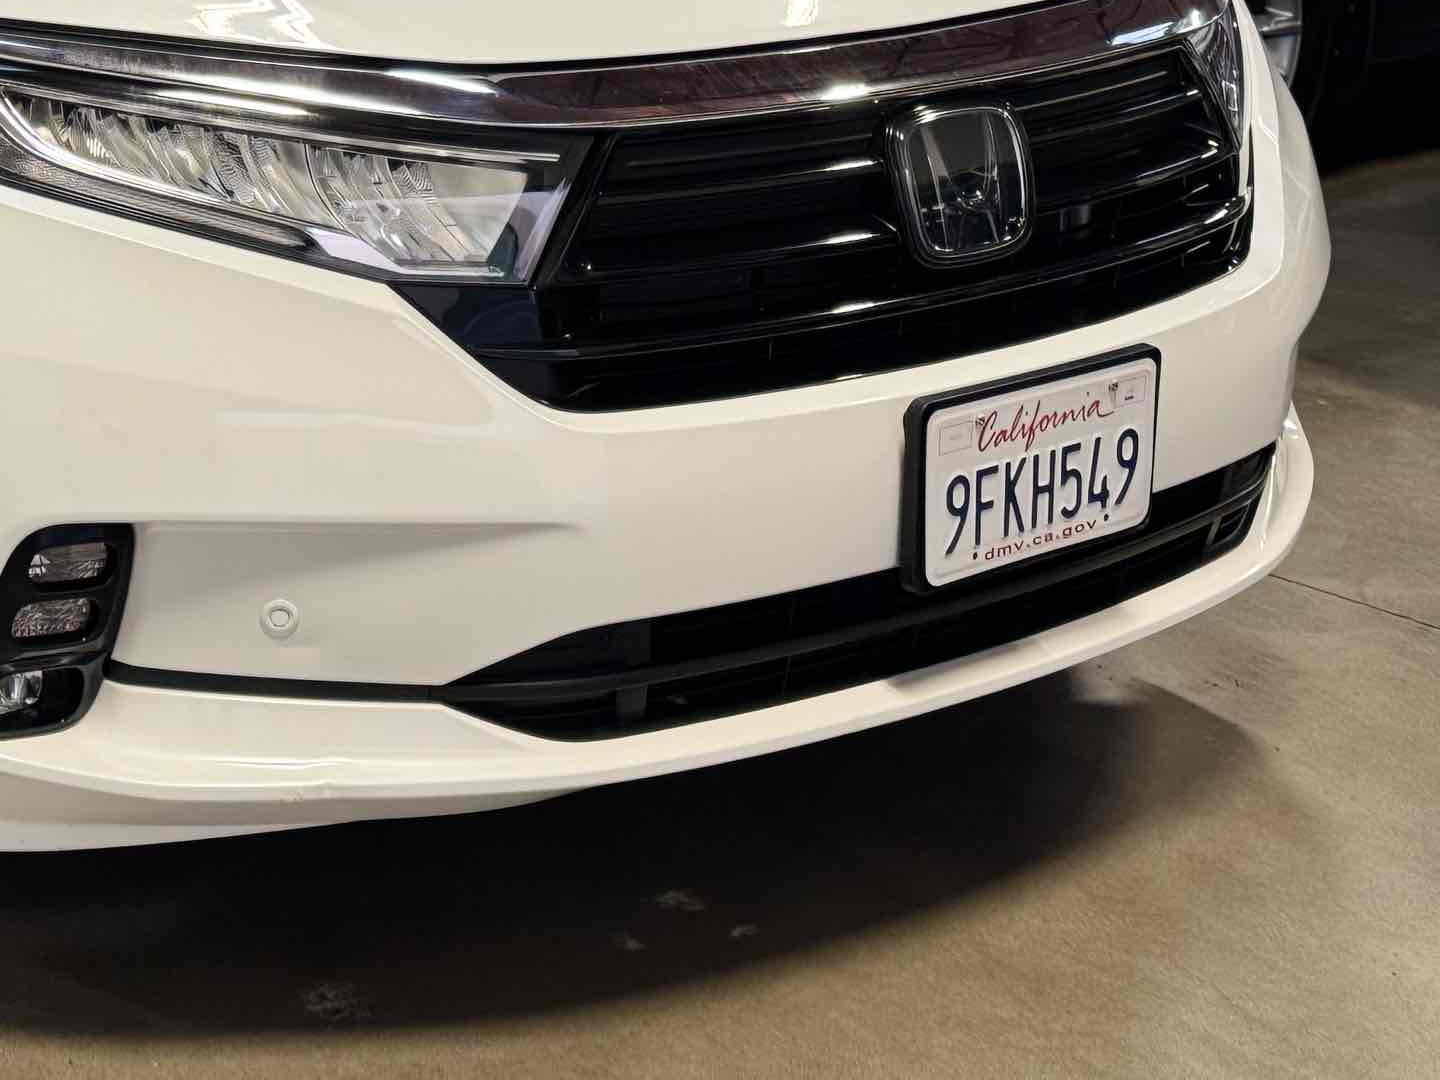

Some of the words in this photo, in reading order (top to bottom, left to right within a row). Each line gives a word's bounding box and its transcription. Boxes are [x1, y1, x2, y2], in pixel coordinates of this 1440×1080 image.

[977, 392, 1114, 452] California
[944, 428, 1140, 558] 9FKH549
[984, 519, 1097, 561] dmv.ca.gov
